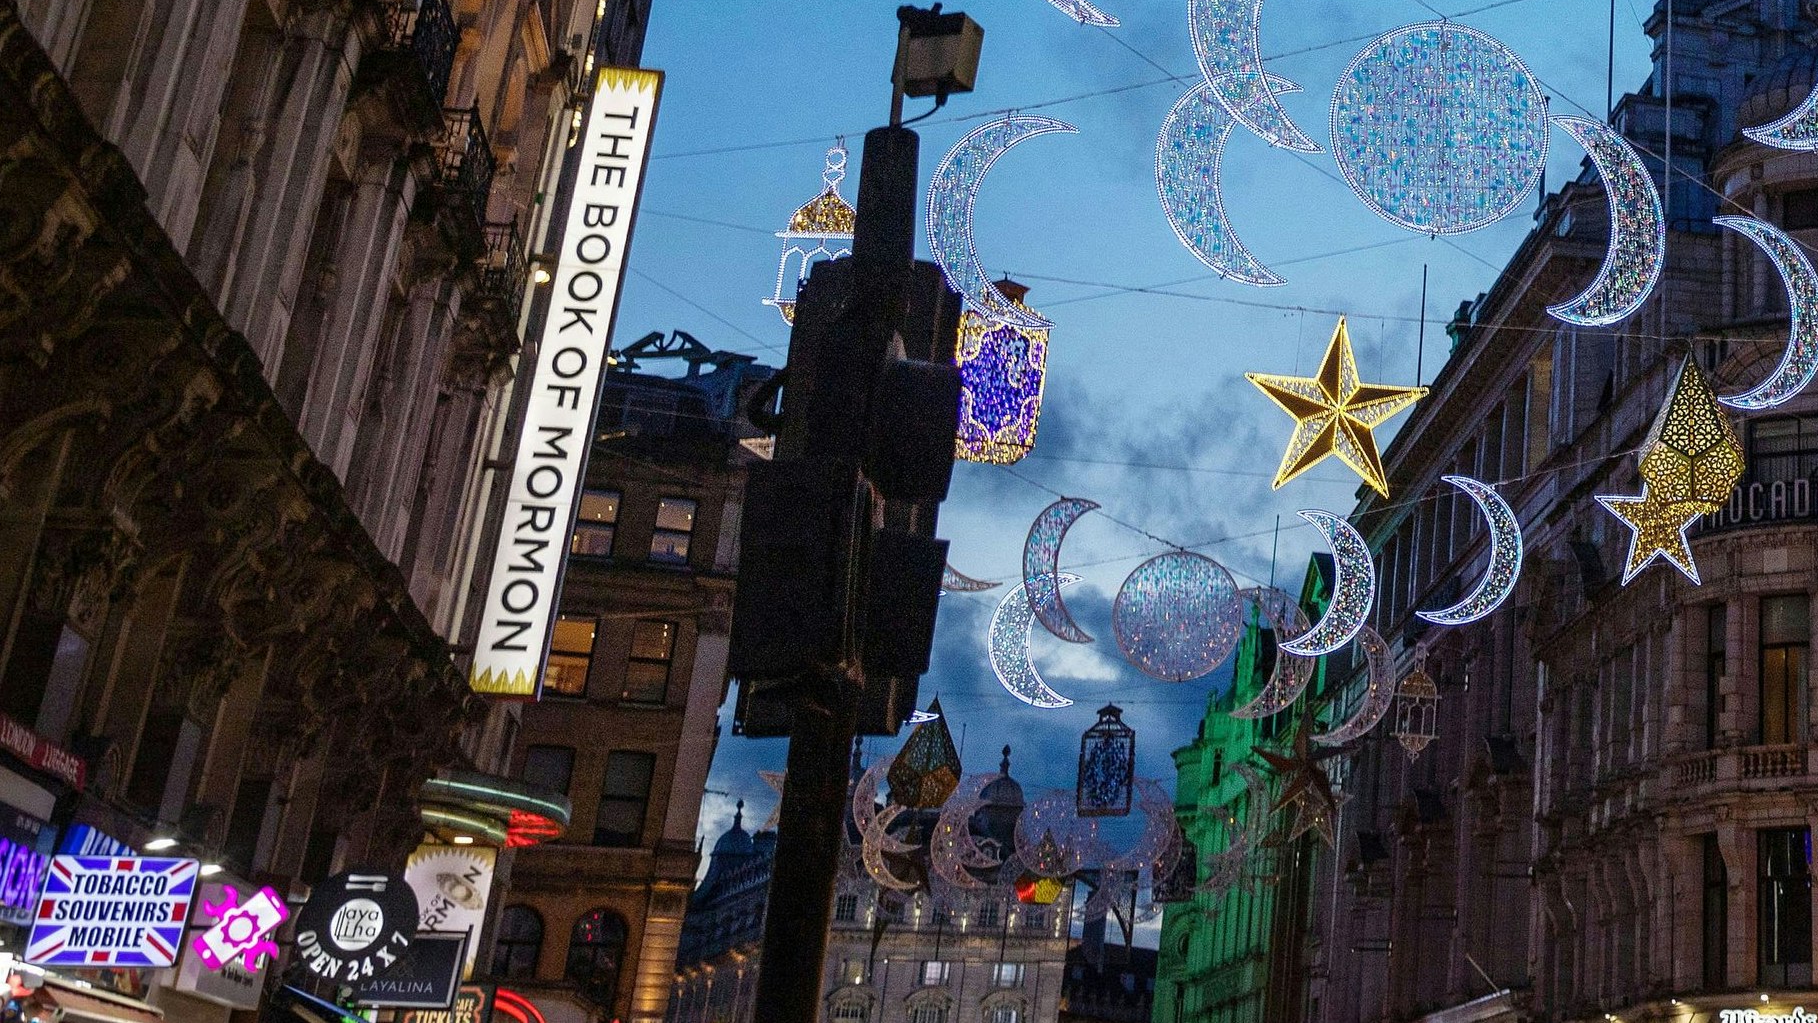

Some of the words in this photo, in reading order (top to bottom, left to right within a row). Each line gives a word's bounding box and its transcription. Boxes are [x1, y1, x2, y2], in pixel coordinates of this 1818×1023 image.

[590, 105, 639, 190] THE
[559, 203, 619, 336] BOOK
[547, 345, 589, 413] OF
[491, 424, 574, 654] MORMON
[73, 873, 168, 896] TOBACCO
[55, 900, 171, 923] SOUVENIRS
[68, 926, 146, 948] MOBILE
[297, 930, 343, 979] OPEN
[347, 956, 374, 981] 24
[376, 945, 397, 968] X
[391, 930, 409, 947] 7
[360, 980, 433, 994] LAYALINA
[415, 1011, 472, 1023] TICKTS
